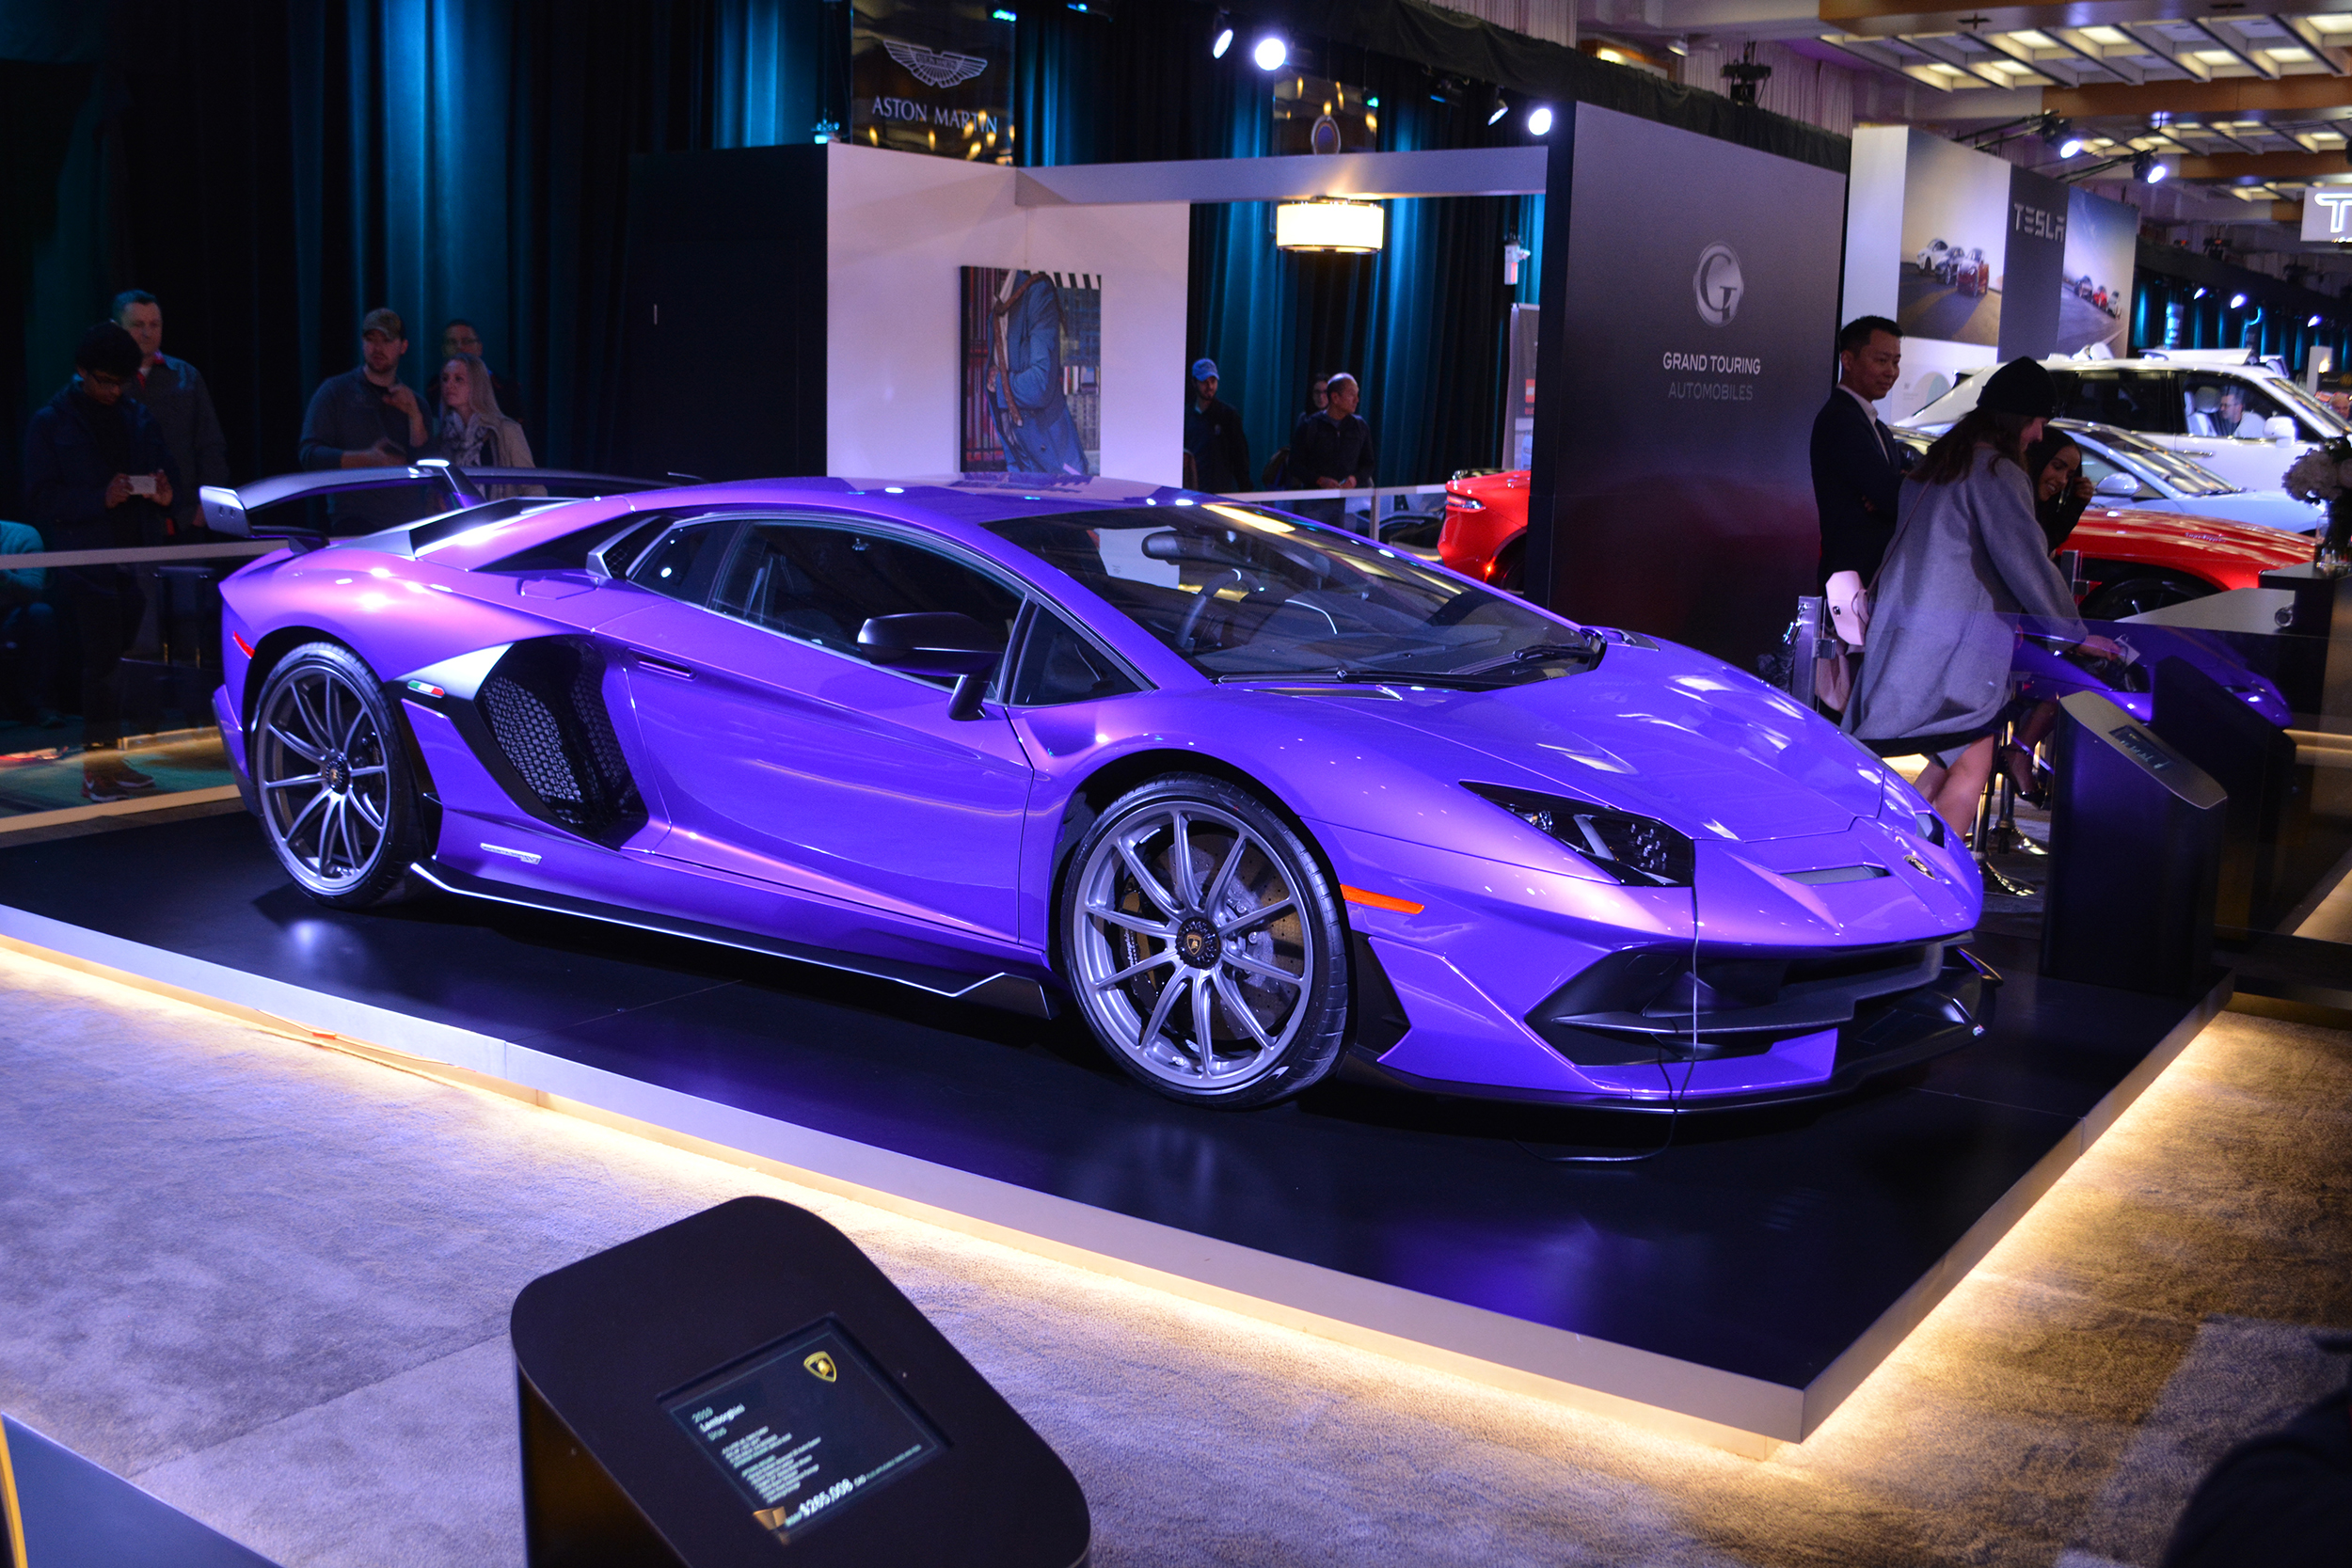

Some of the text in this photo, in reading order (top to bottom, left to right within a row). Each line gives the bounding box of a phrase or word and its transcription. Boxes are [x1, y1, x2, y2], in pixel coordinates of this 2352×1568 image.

[872, 95, 998, 135] ASTON MARTIN
[2013, 202, 2066, 243] TESLA
[1662, 352, 1761, 375] GRAND TOURING
[1668, 381, 1754, 401] AUTOMOBILES
